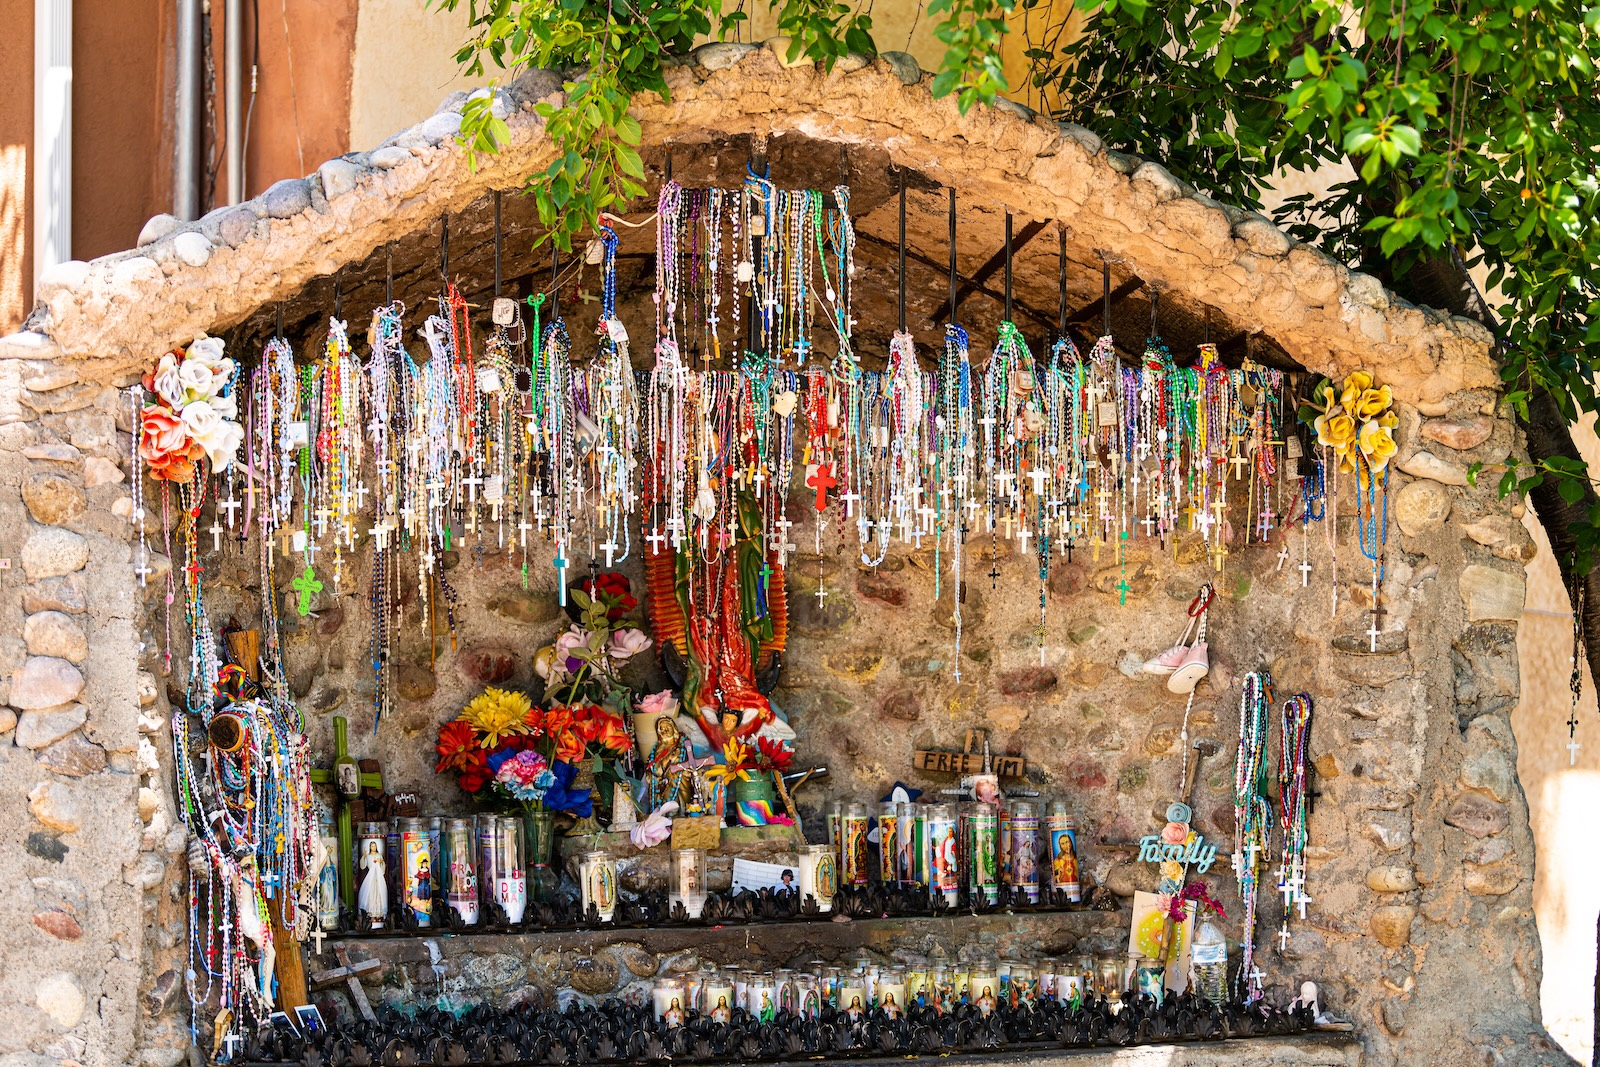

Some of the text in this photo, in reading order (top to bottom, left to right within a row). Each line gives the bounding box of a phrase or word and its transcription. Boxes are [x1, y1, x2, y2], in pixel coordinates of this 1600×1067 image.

[923, 753, 970, 774] FREE
[1137, 835, 1217, 874] Family
[501, 881, 527, 893] DES
[501, 892, 527, 904] MAR
